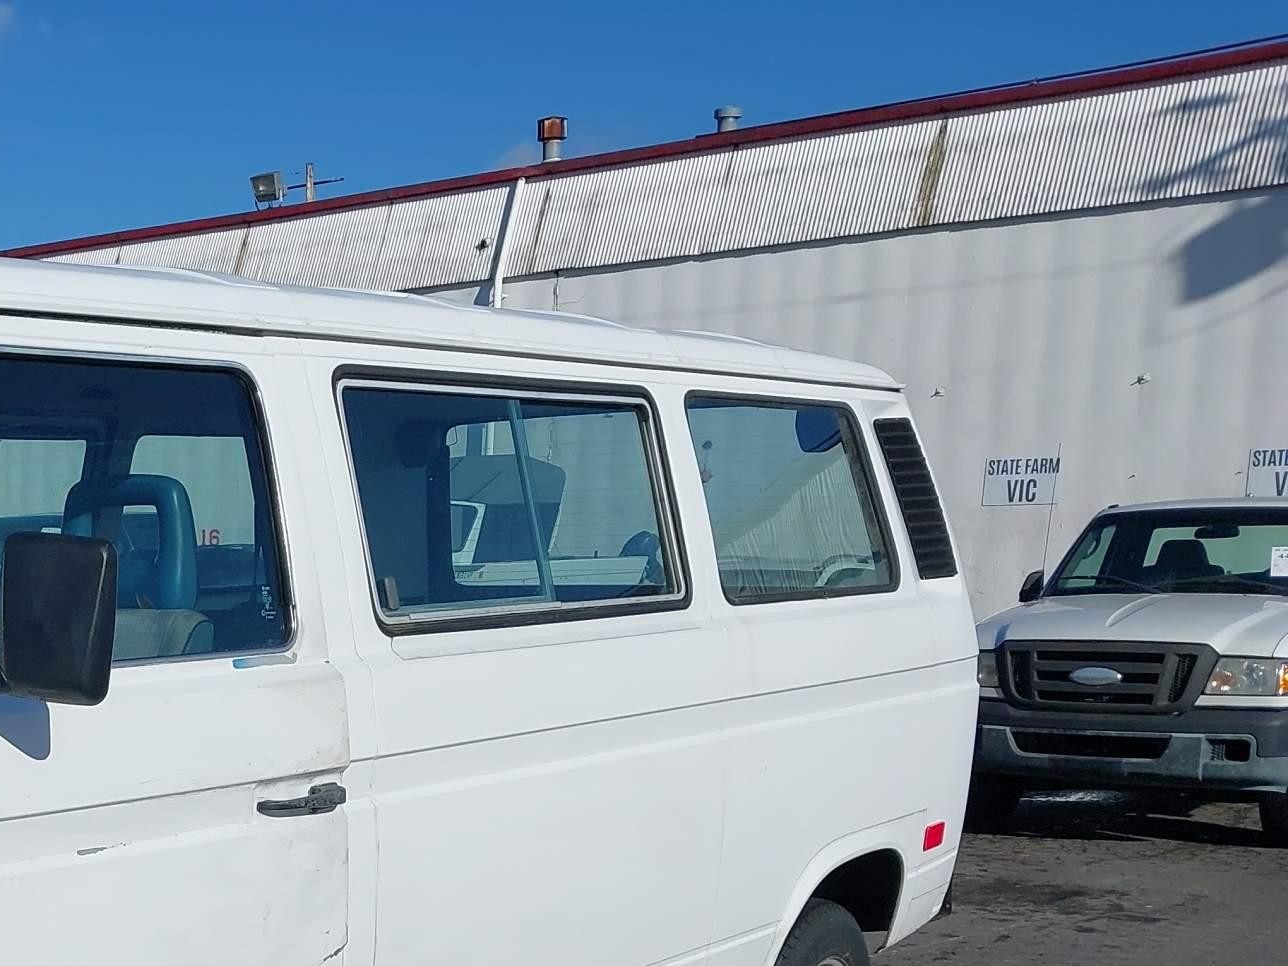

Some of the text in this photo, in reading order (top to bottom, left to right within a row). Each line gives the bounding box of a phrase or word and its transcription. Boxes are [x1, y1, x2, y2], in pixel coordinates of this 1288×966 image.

[987, 457, 1061, 476] STATE FARM
[1007, 478, 1037, 503] VIC
[201, 528, 220, 546] 16
